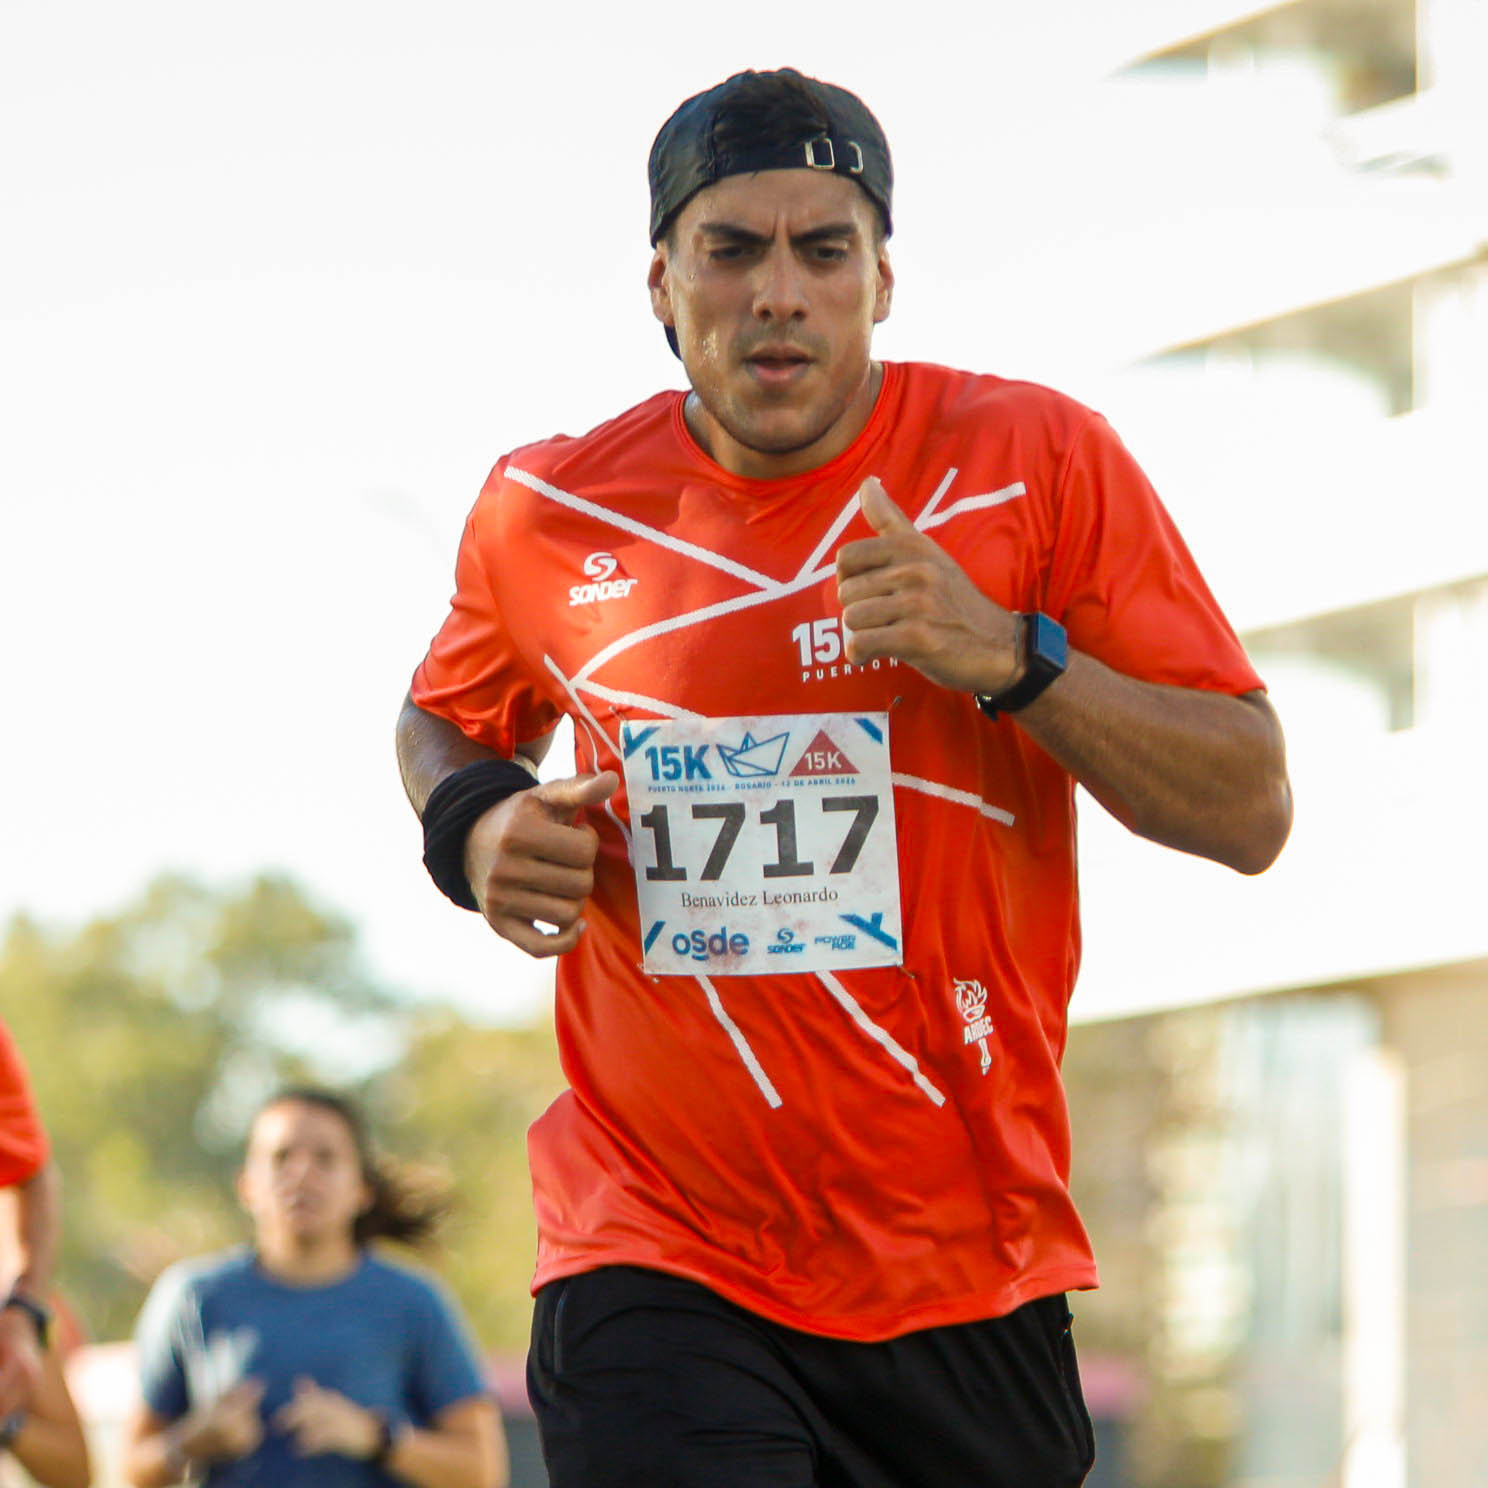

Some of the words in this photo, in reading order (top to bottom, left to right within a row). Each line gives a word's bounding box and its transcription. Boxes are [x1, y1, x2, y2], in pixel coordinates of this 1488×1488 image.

[644, 744, 712, 781] 15K
[803, 751, 843, 771] 15K
[735, 781, 772, 790] ROSARIO
[794, 779, 804, 787] DE
[807, 778, 832, 786] ABRIL
[640, 795, 880, 881] 1717
[681, 891, 758, 908] Benavidez
[763, 886, 839, 906] Leonardo
[671, 926, 750, 957] osde
